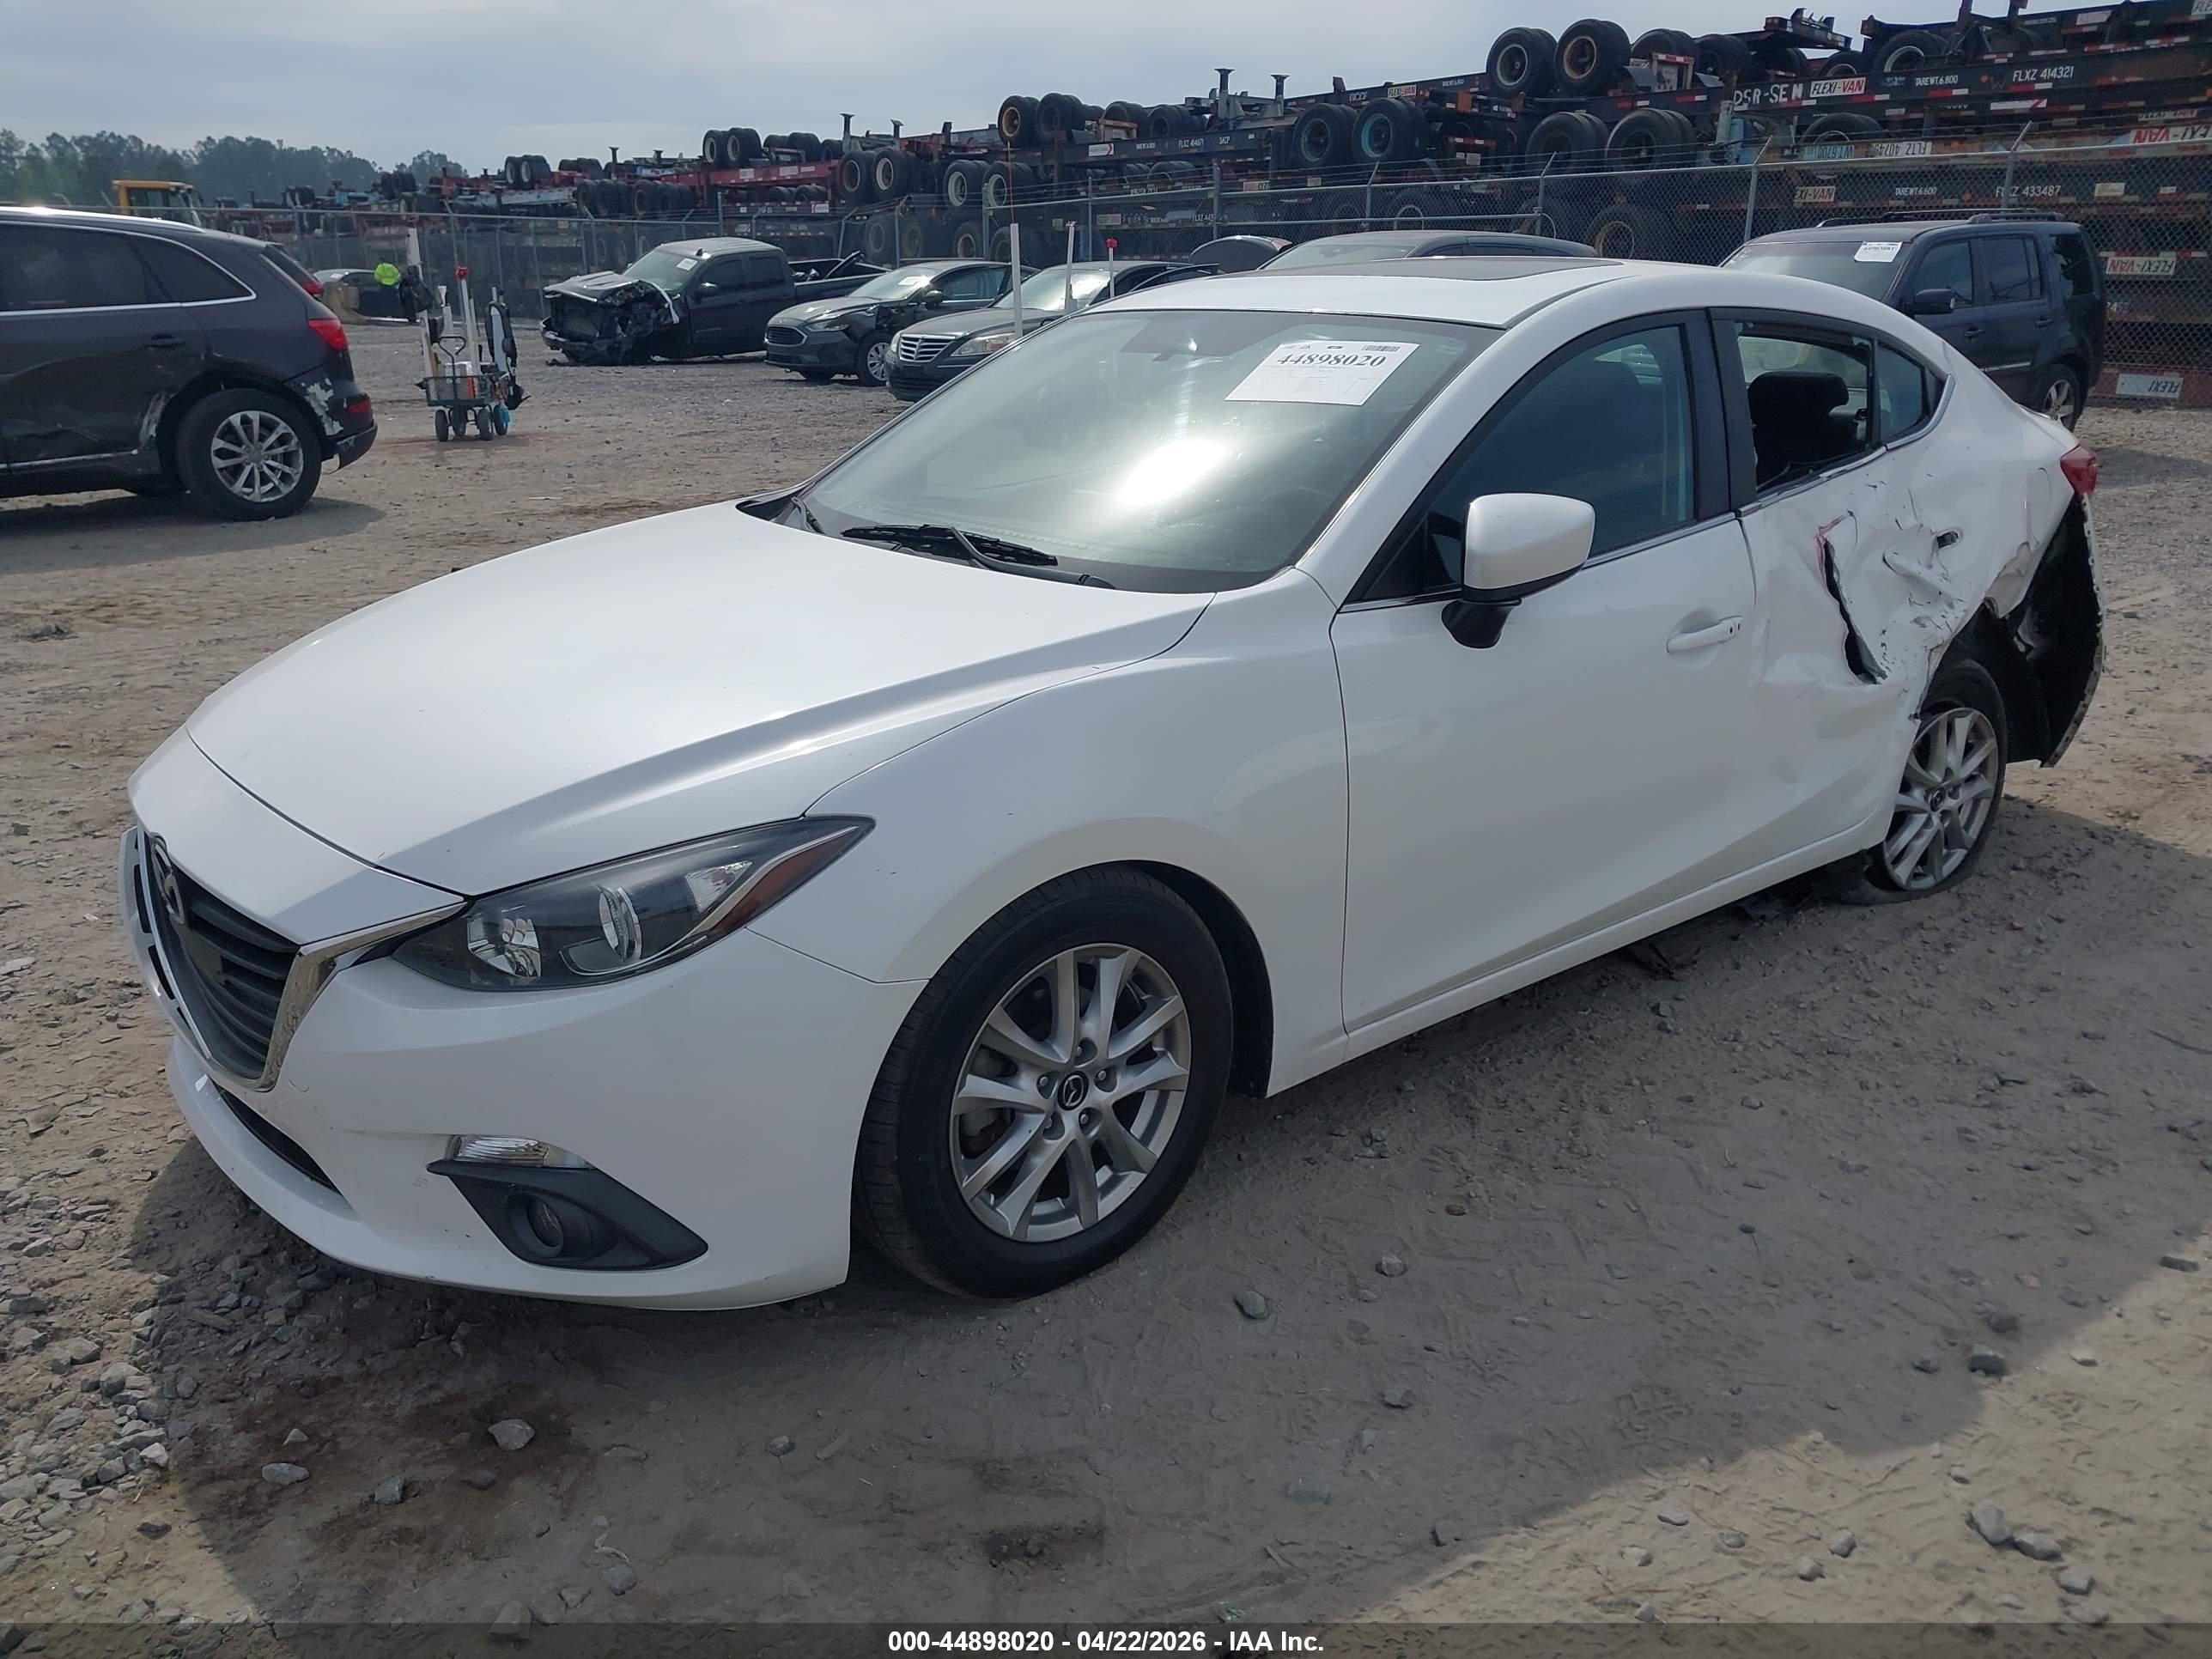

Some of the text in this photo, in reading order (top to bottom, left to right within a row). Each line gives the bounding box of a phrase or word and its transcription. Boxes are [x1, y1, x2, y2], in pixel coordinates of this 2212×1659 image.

[2012, 65, 2075, 82] FLXZ 414321
[1811, 80, 1864, 96] FLEXI-VAN
[2022, 185, 2061, 197] 433487
[1278, 353, 1387, 368] 44898020
[2148, 380, 2179, 393] FLEXI
